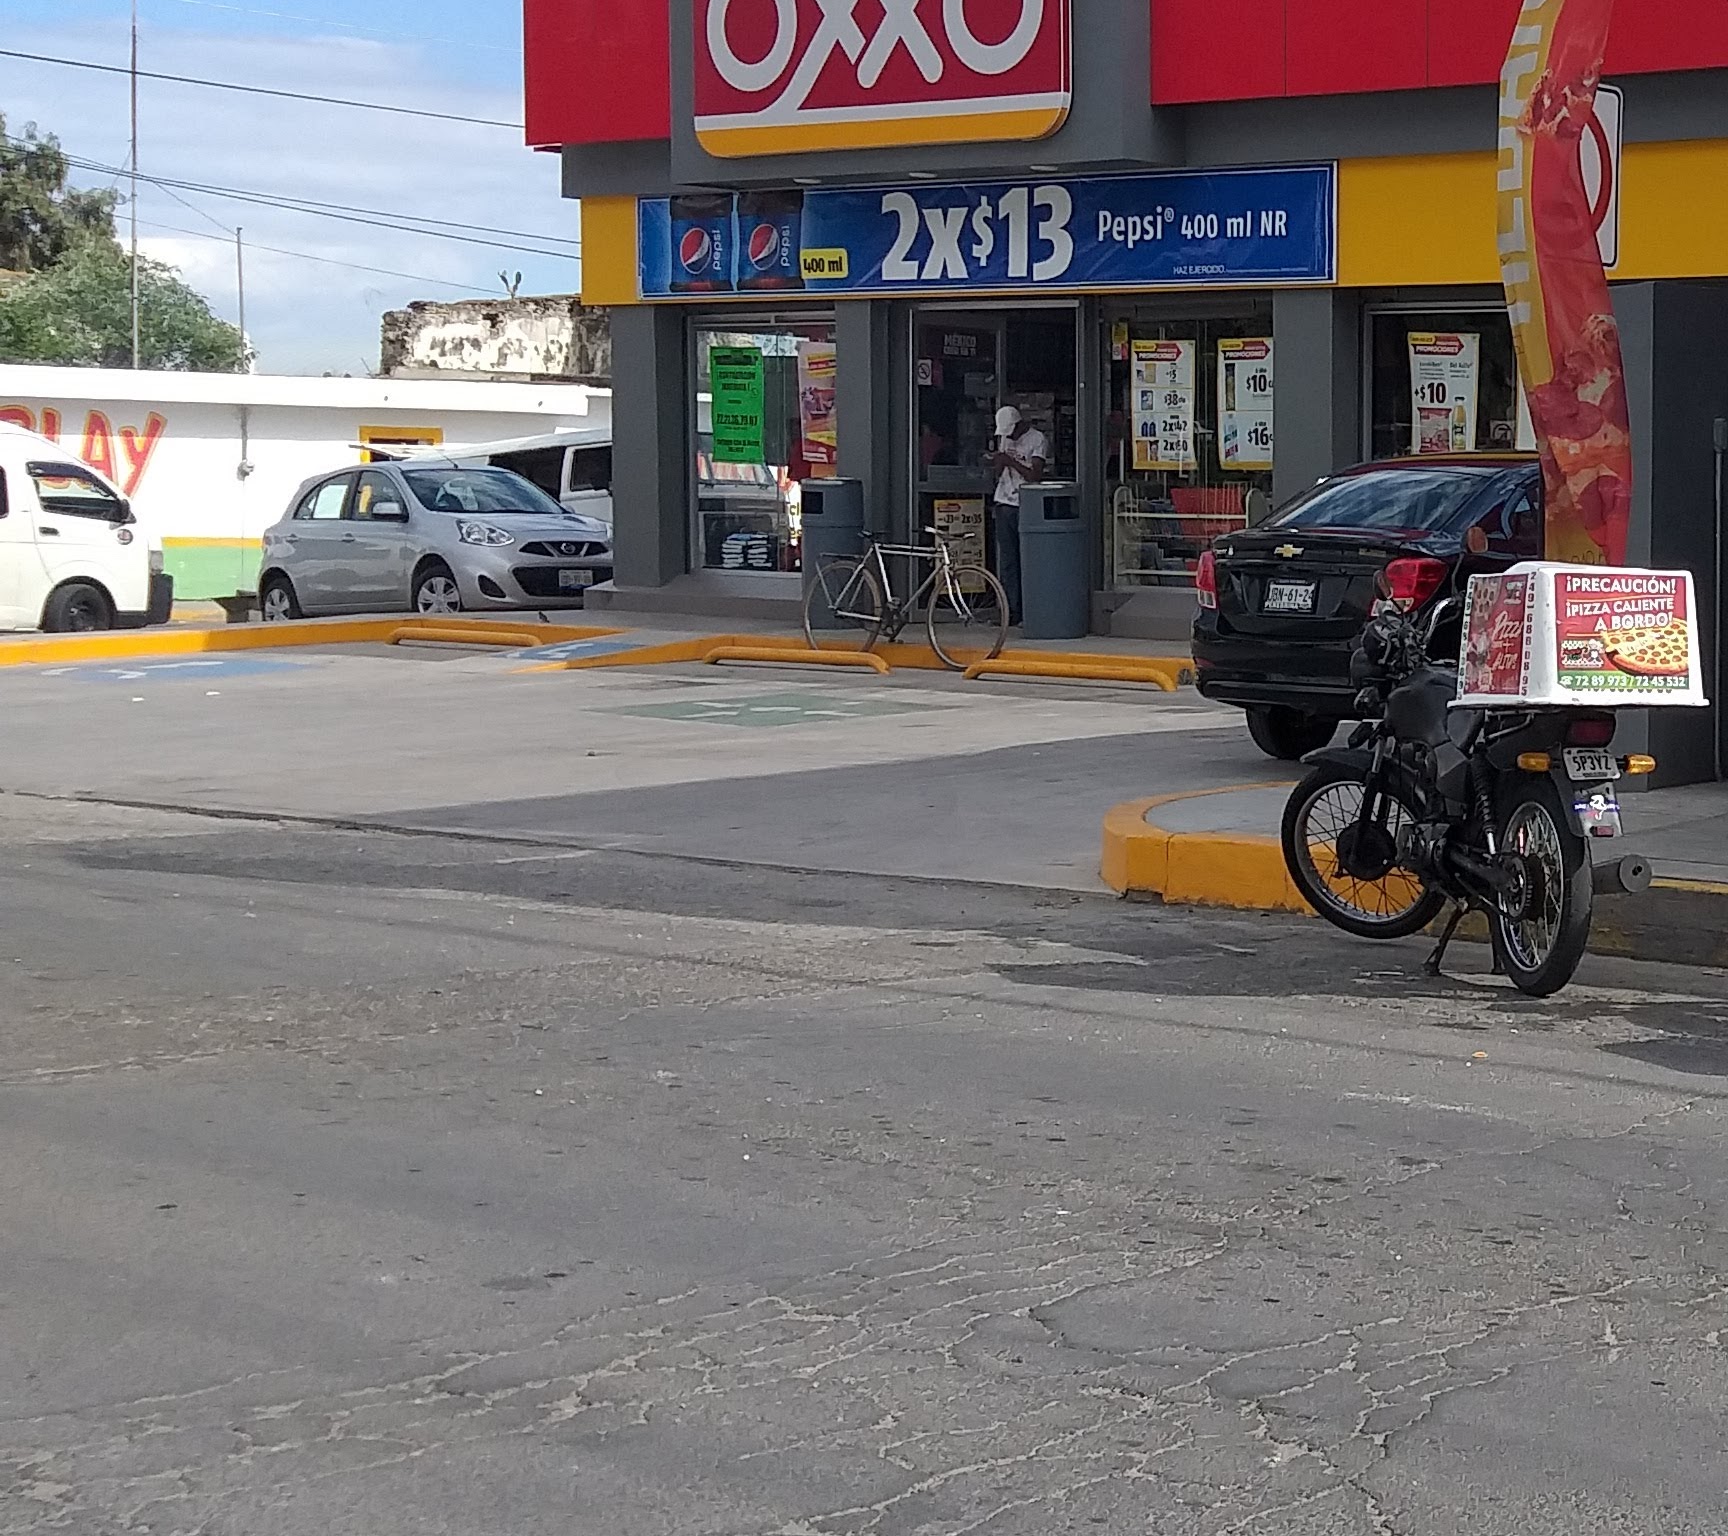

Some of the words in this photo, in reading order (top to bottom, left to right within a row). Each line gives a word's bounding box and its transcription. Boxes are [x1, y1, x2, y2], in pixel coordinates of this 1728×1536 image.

[1180, 213, 1219, 240] 400
[1225, 210, 1251, 239] ml
[1258, 209, 1288, 237] NR
[712, 228, 722, 272] pepsi
[780, 223, 792, 268] pepsi
[803, 256, 826, 274] 400
[827, 255, 844, 273] ml
[1566, 575, 1677, 595] ¡PRECAUCIÓN!
[1566, 601, 1612, 618] ¡PIZZA
[1613, 597, 1675, 613] CALIENTE
[1594, 616, 1608, 632] A
[1611, 611, 1674, 631] BORDO!
[1574, 675, 1590, 687] 72
[1591, 675, 1605, 687] 89
[1607, 675, 1626, 687] 973
[1636, 675, 1650, 687] 72
[1651, 675, 1665, 687] 45
[1666, 676, 1686, 687] 532
